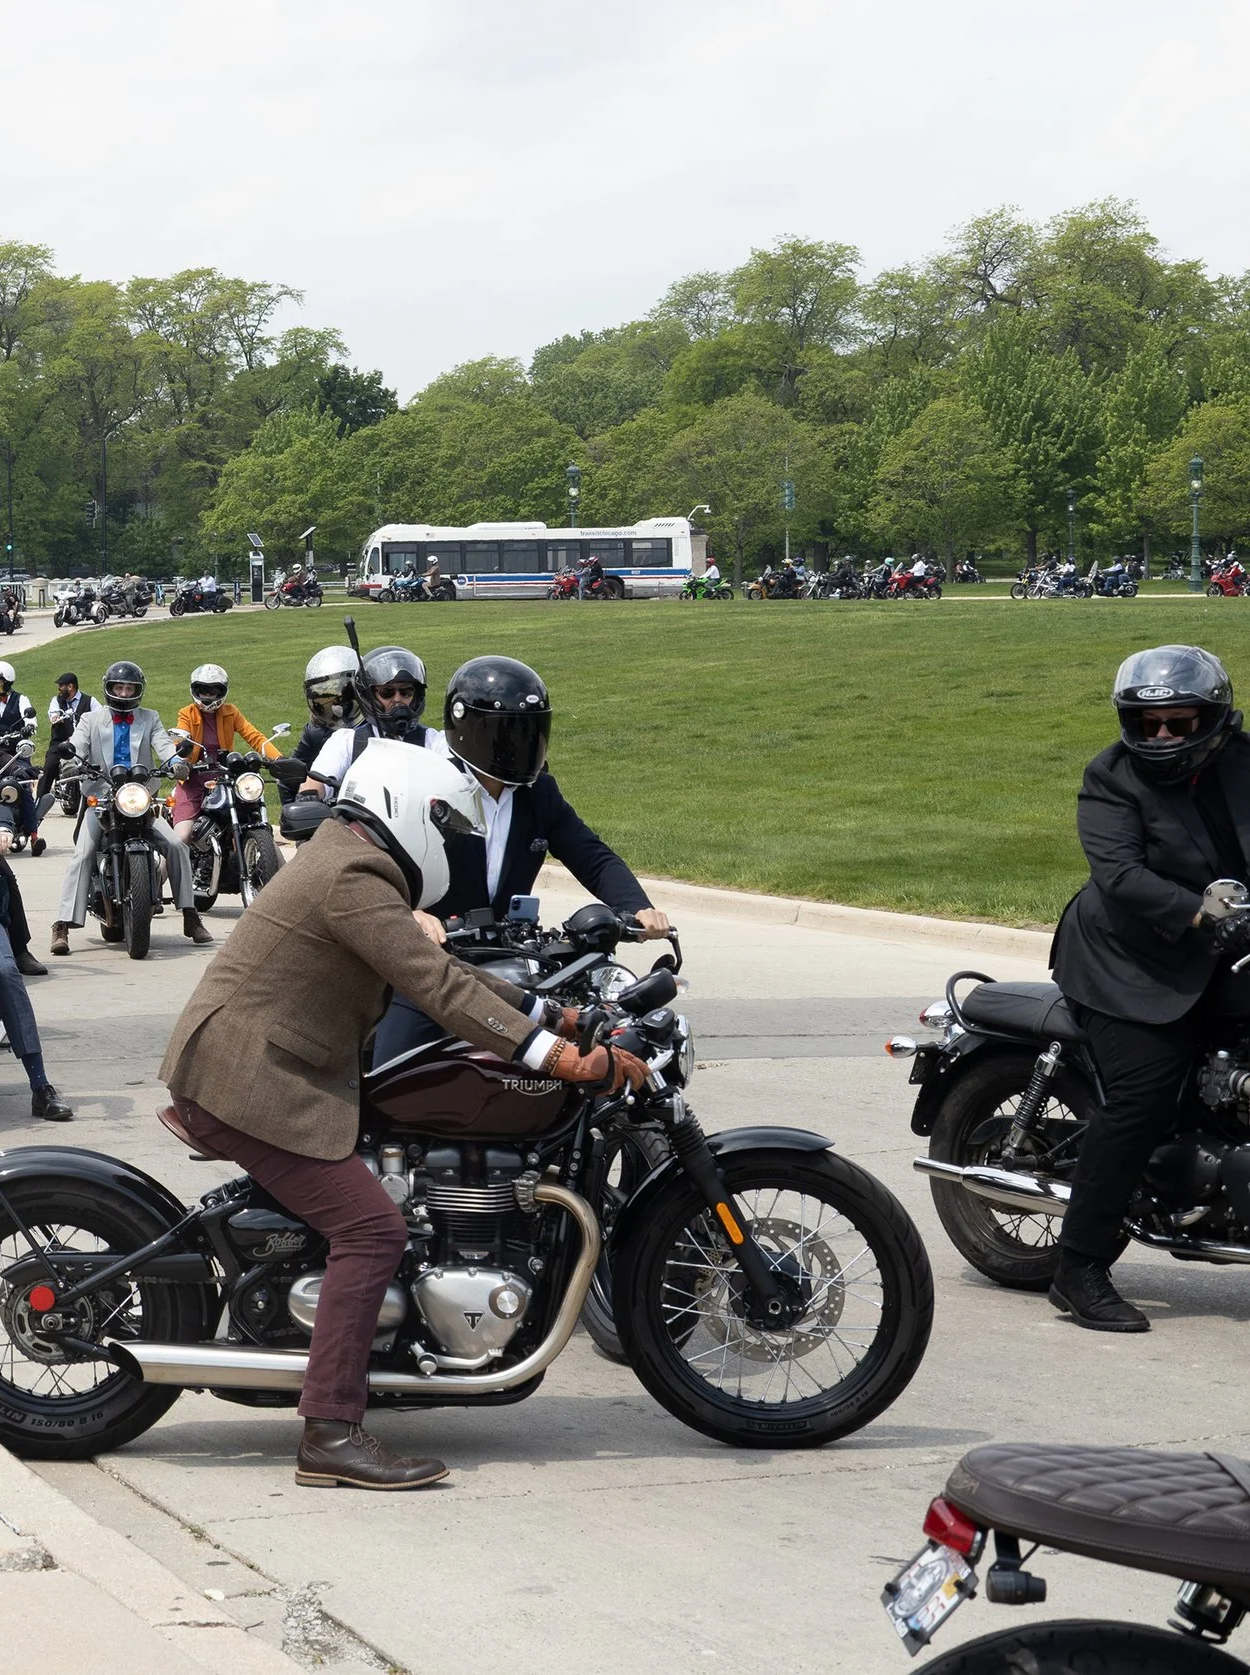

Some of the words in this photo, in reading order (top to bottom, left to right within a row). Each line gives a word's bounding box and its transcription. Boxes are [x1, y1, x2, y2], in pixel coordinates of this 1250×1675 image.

[1141, 689, 1170, 698] HJC
[502, 1079, 562, 1095] TRIUMPH
[253, 1232, 307, 1257] Bobber
[30, 1417, 75, 1428] 150/80
[760, 1421, 807, 1431] MICHELIN
